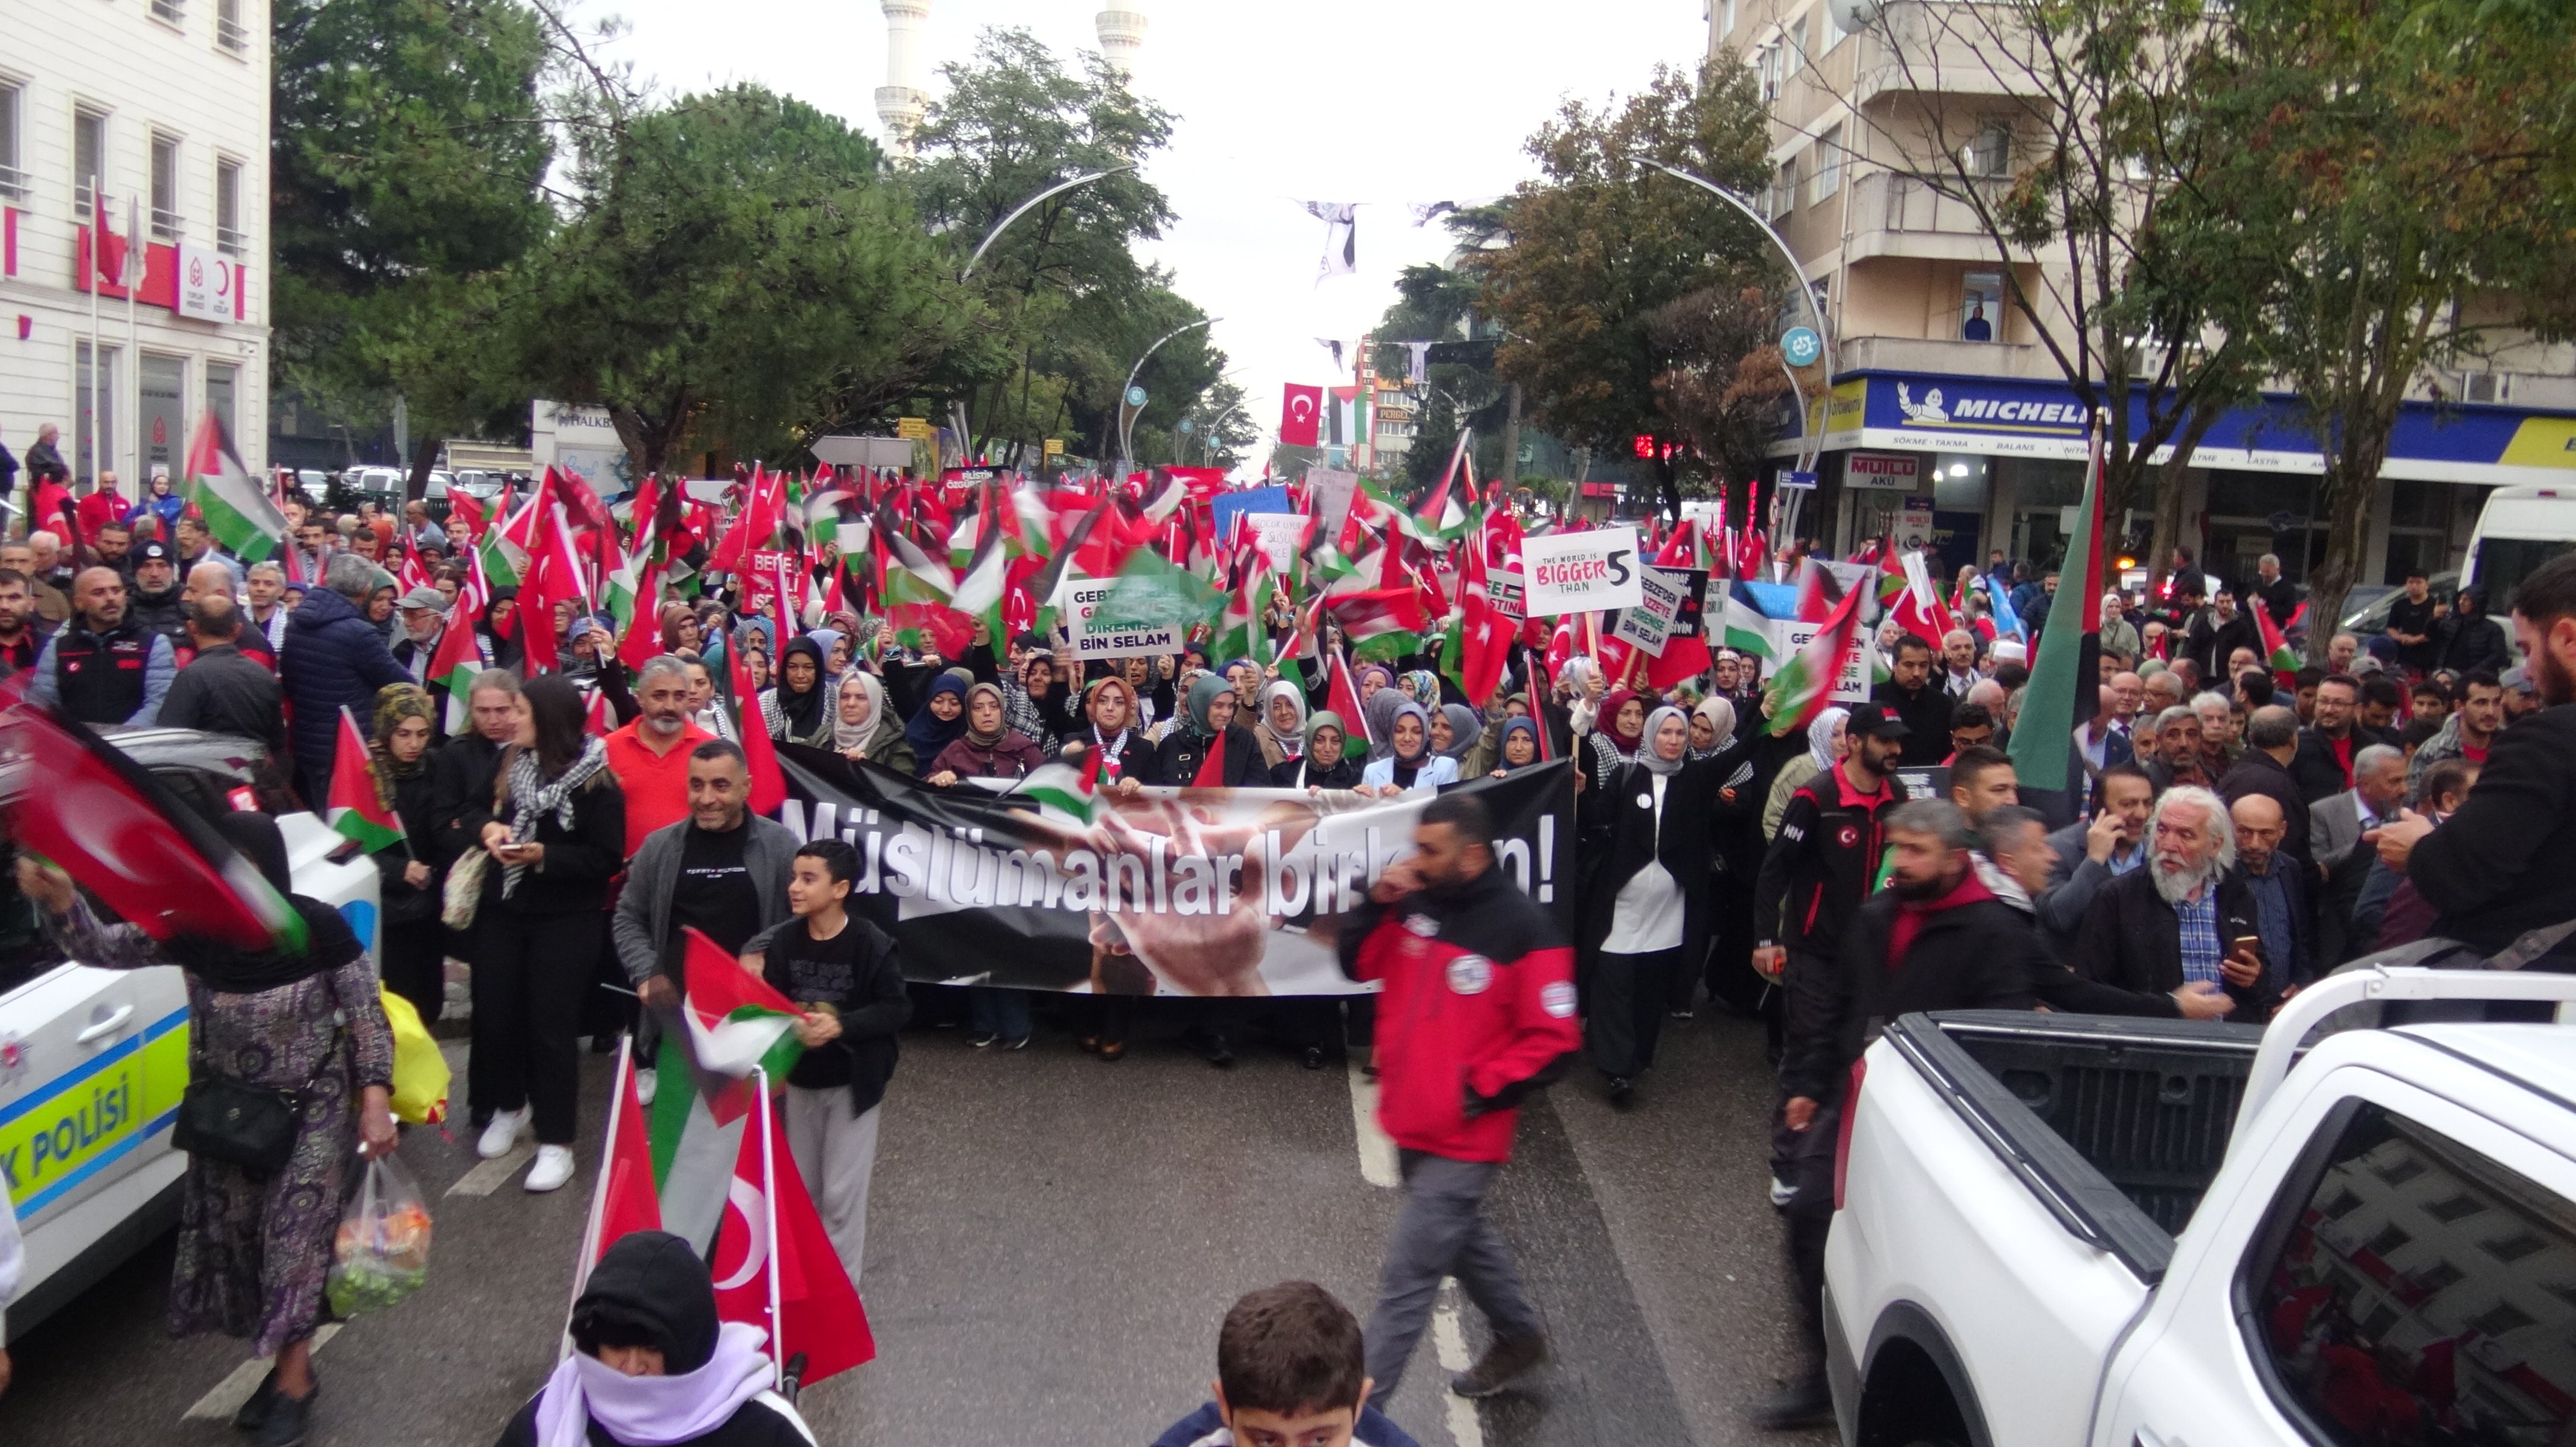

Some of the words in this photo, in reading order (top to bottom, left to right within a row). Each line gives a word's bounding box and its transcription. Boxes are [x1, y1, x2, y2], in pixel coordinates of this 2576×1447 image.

[1870, 476, 1895, 486] AKÜ
[1560, 554, 1586, 564] WORLD
[1607, 550, 1632, 586] 5
[1536, 559, 1608, 586] BIGGER
[1559, 583, 1590, 594] THAN
[1080, 635, 1108, 651] BİN
[1113, 633, 1171, 648] SELAM
[781, 799, 1242, 917] Müslümanlar
[1266, 815, 1555, 918] birln!
[31, 1072, 130, 1178] POLİSİ
